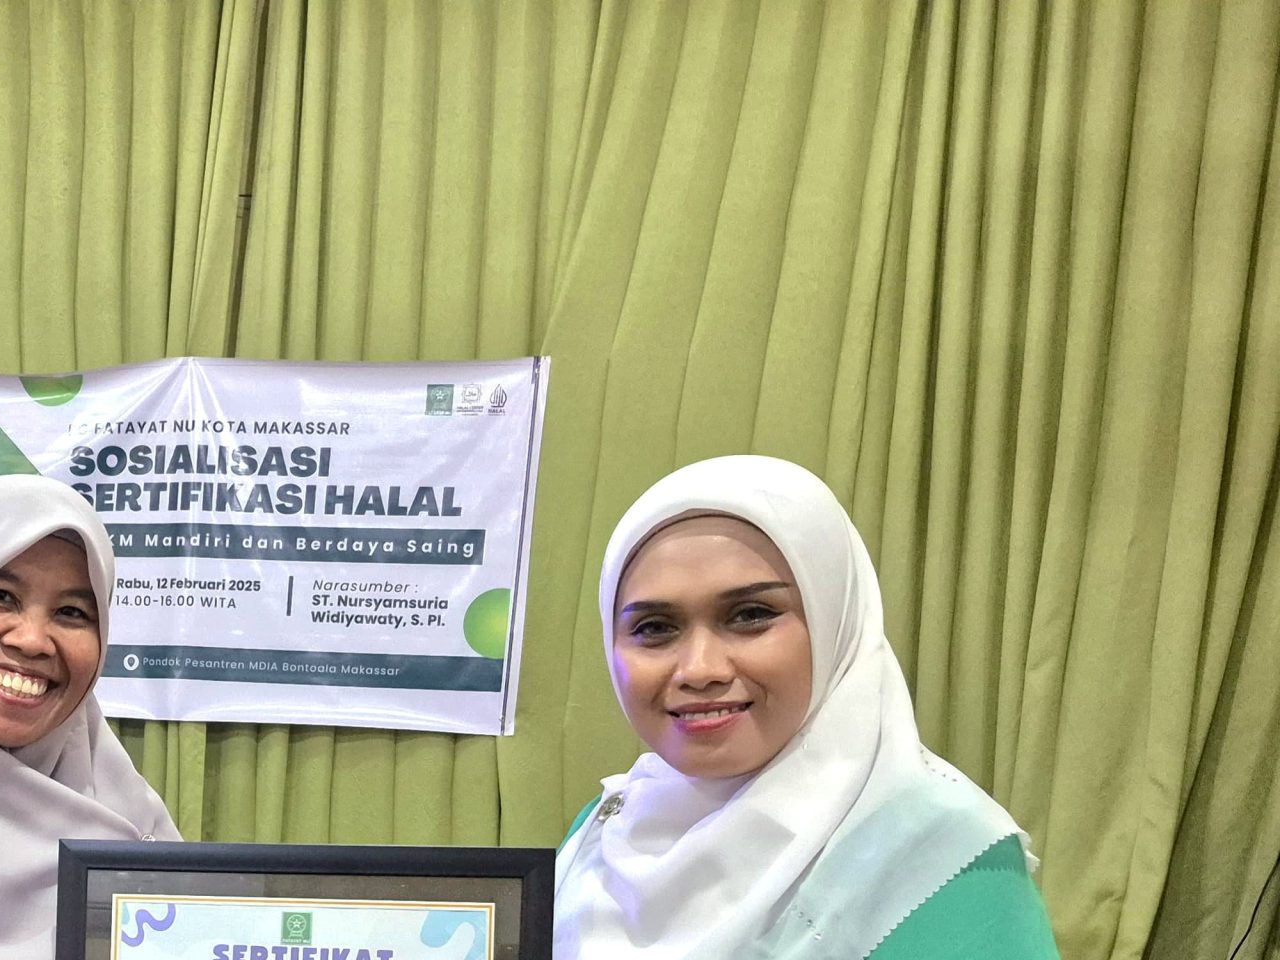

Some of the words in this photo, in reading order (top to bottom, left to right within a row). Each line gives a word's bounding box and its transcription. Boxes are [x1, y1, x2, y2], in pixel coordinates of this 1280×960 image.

[94, 420, 168, 435] FATAYAT
[173, 420, 196, 433] NU
[202, 420, 247, 434] KOTA
[253, 421, 351, 436] MAKASSAR
[69, 444, 332, 477] SOSIALISASI
[324, 485, 462, 516] HALAL
[145, 533, 230, 548] Mandiri
[242, 535, 283, 549] dan
[296, 537, 394, 556] Berdaya
[407, 539, 475, 558] Saing
[116, 578, 154, 591] Rabu,
[157, 578, 167, 589] 12
[170, 577, 225, 591] Februari
[228, 580, 261, 591] 2025
[312, 580, 410, 594] Narasumber
[116, 595, 194, 607] 14.00-16.00
[200, 597, 236, 609] WITA
[312, 595, 334, 607] ST.
[337, 595, 449, 611] Nursyamsuria
[311, 611, 407, 629] Widiyawaty,
[410, 615, 424, 626] S.
[142, 657, 181, 667] Pondok
[185, 658, 245, 670] Pesantren
[249, 661, 278, 671] MDIA
[282, 662, 337, 673] Bontoala
[340, 665, 400, 676] Makassar
